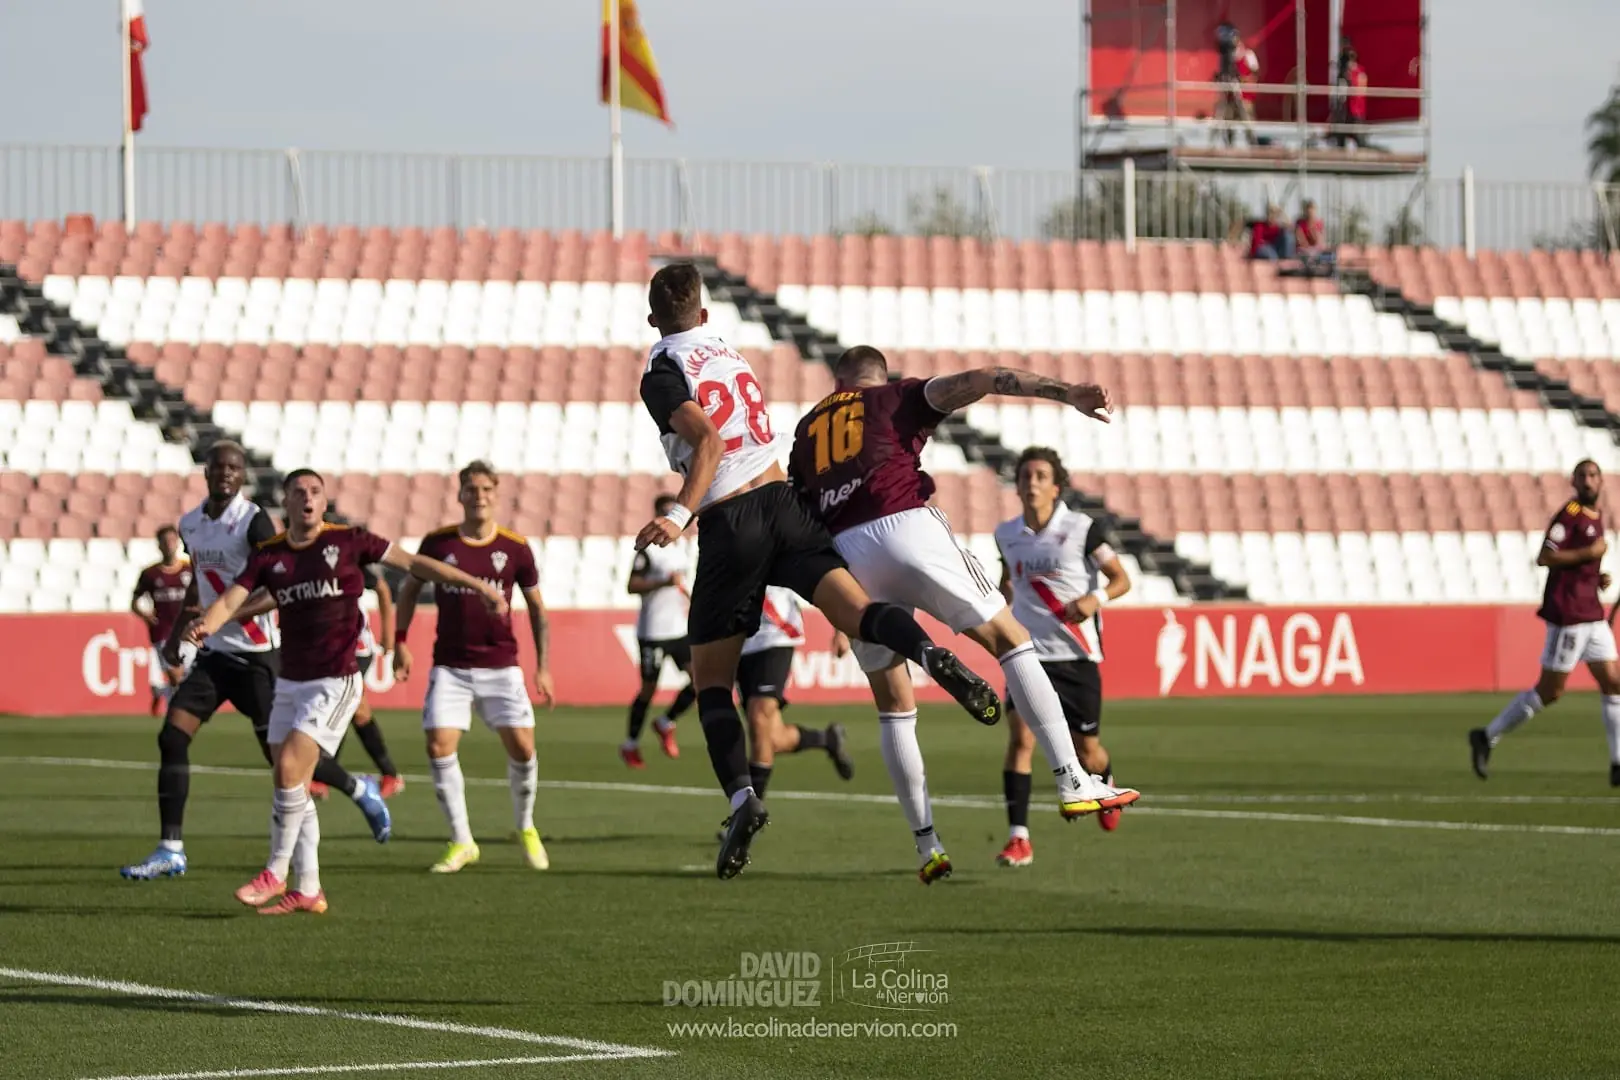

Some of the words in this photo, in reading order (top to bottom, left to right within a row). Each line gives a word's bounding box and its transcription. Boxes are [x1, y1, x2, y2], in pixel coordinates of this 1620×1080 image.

[696, 371, 775, 456] 28
[807, 400, 864, 475] 16
[1193, 612, 1365, 688] NAGA
